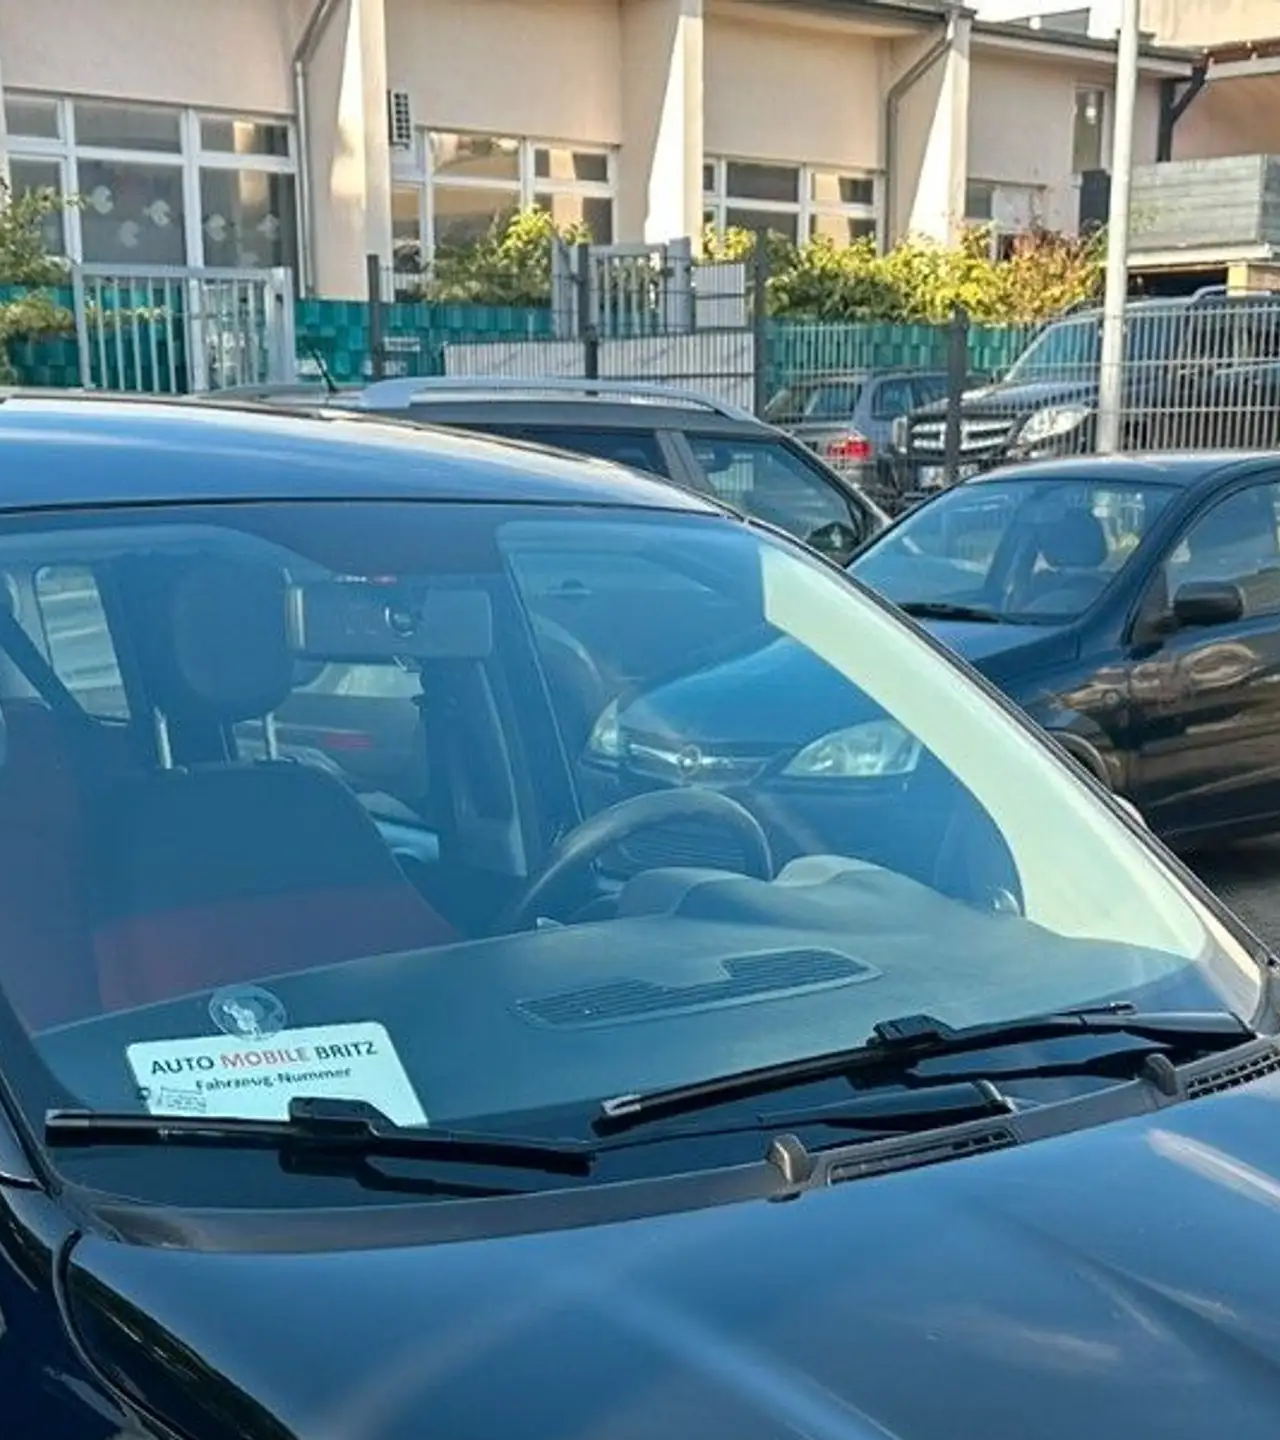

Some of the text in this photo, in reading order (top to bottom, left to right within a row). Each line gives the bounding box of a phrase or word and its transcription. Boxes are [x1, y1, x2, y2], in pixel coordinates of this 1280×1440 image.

[151, 1040, 378, 1075] AUTO MOBILE BRITZ
[196, 1067, 352, 1091] Fahrzeug-Nummer
